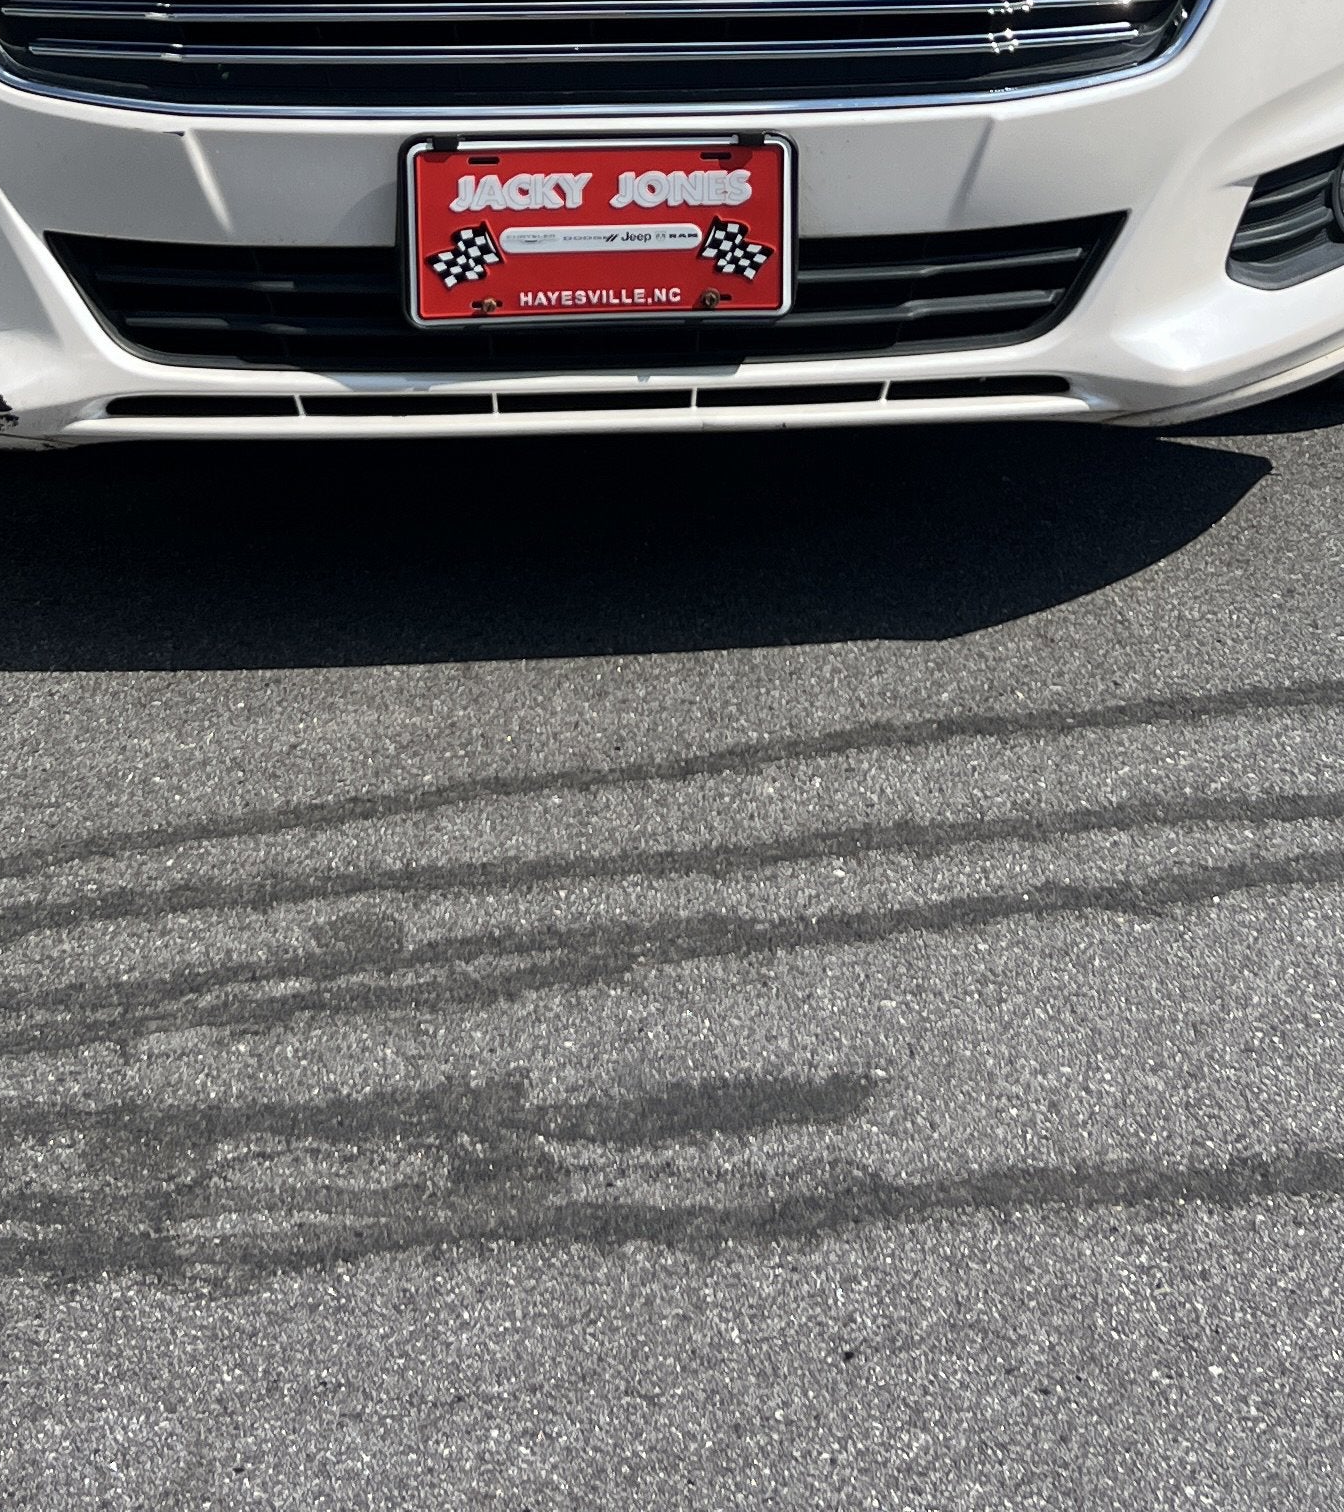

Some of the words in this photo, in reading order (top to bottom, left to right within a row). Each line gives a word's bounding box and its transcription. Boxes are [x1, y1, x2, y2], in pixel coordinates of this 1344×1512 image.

[449, 172, 593, 212] JACKY
[609, 169, 753, 209] JONES
[620, 231, 652, 243] Jeep
